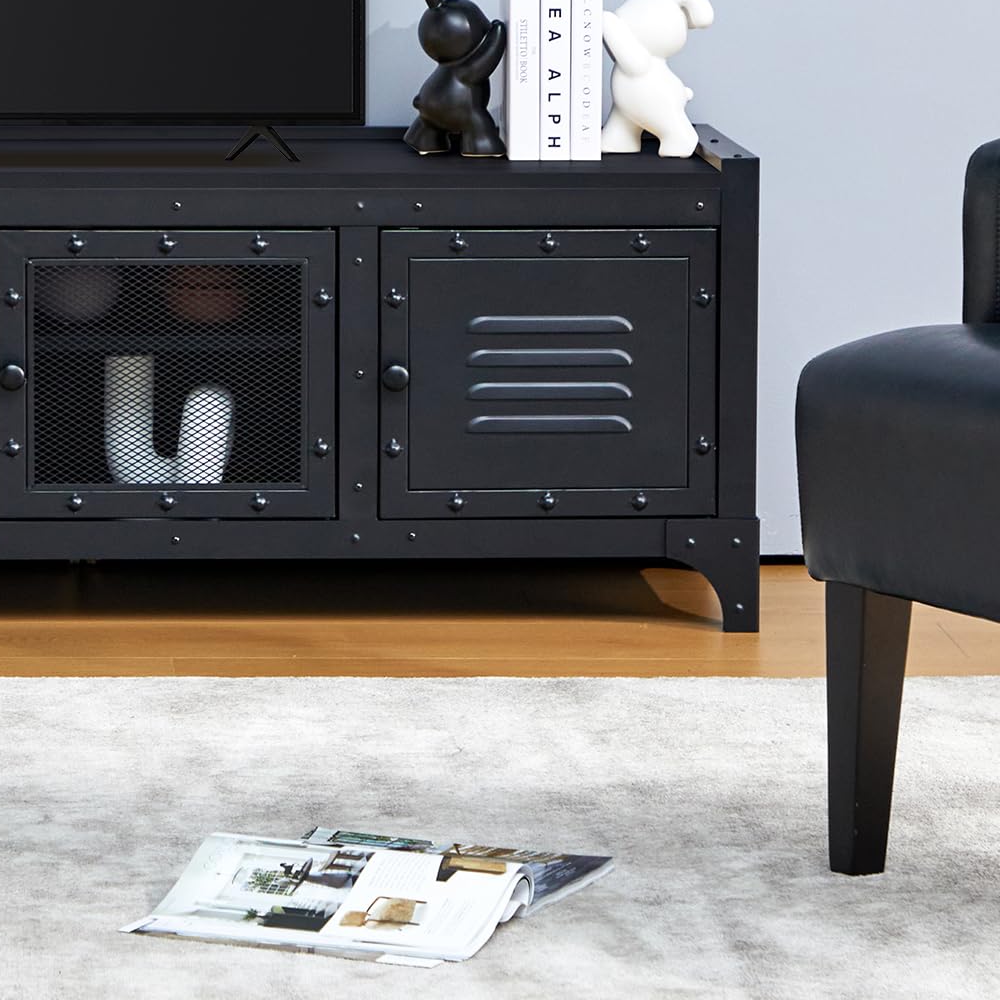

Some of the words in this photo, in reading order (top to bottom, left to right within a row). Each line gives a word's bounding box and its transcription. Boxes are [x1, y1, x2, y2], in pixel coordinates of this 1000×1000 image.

[519, 18, 528, 58] STILETTO
[519, 60, 528, 84] BOOK
[548, 68, 562, 148] ALPH
